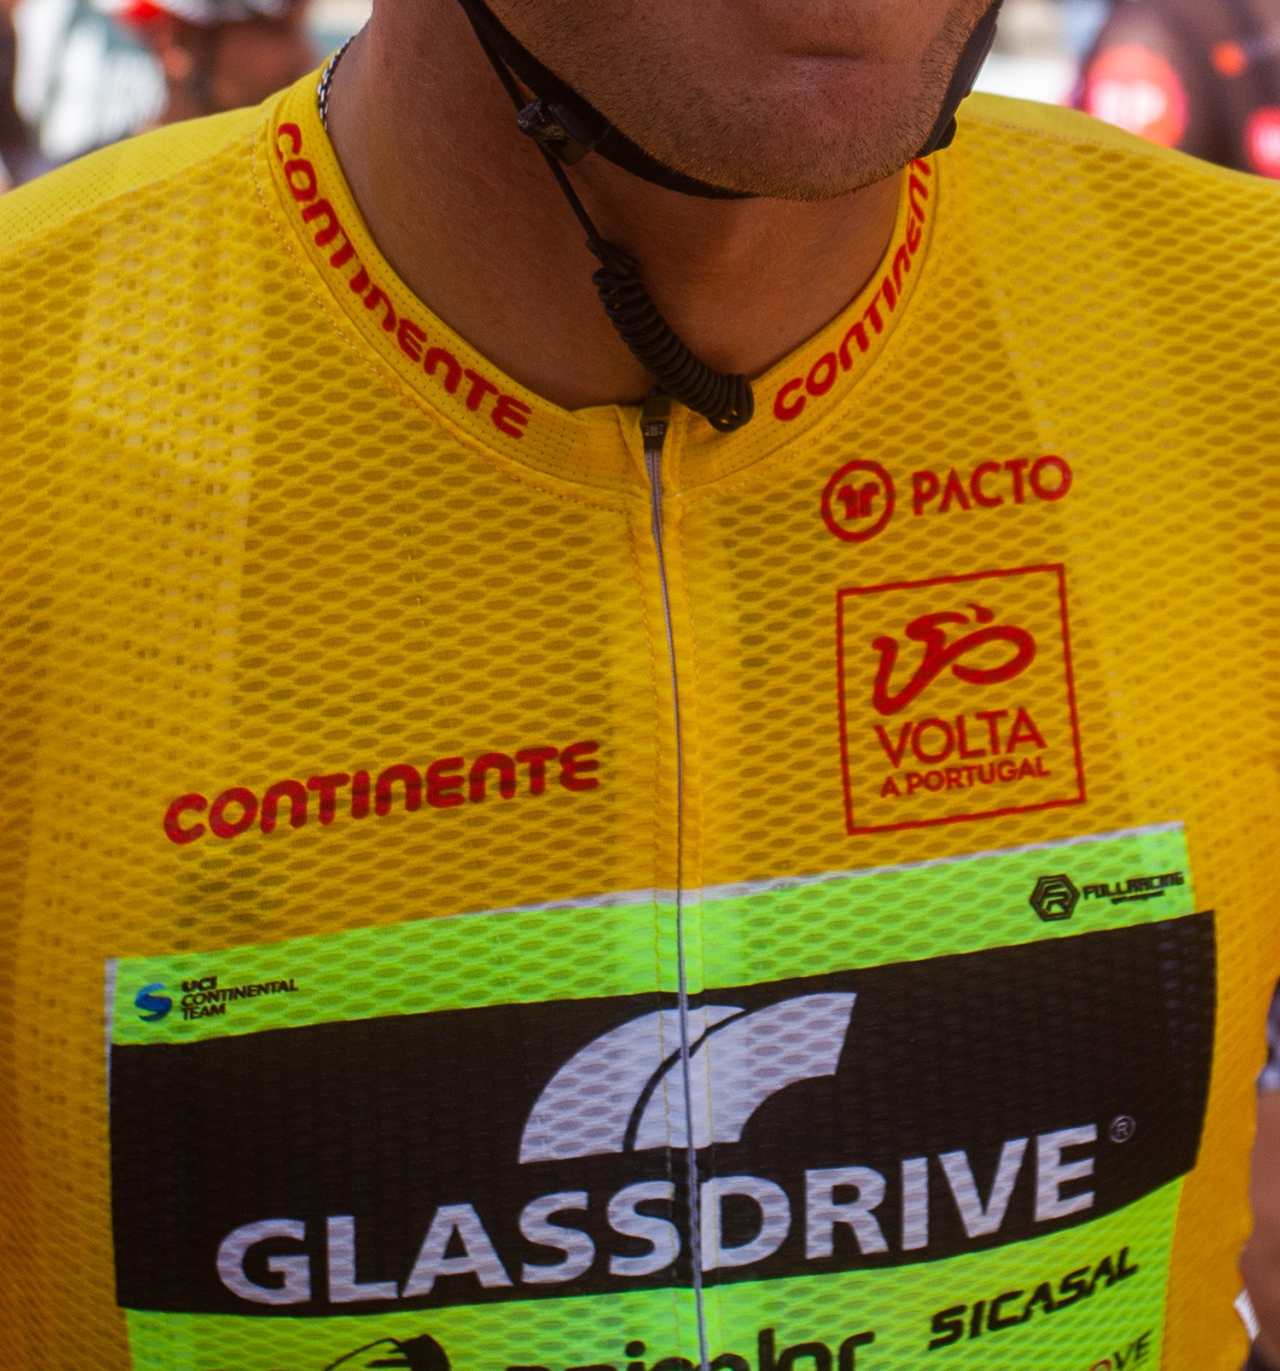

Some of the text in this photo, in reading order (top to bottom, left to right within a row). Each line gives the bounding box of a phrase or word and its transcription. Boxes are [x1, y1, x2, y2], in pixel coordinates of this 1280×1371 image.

[276, 123, 532, 439] CONTINENTE
[772, 157, 932, 422] CONTINENT
[912, 454, 1072, 516] PACTO
[873, 706, 1048, 769] VOLTA
[163, 739, 601, 845] CONTINENTE
[880, 756, 1051, 799] A PORTUGAL
[181, 976, 218, 992] UCI
[181, 979, 299, 1007] CONTINENTAL
[181, 1002, 226, 1021] TEAM
[215, 1122, 1098, 1306] GLASSDRIVE
[927, 1246, 1139, 1351] SICASAL
